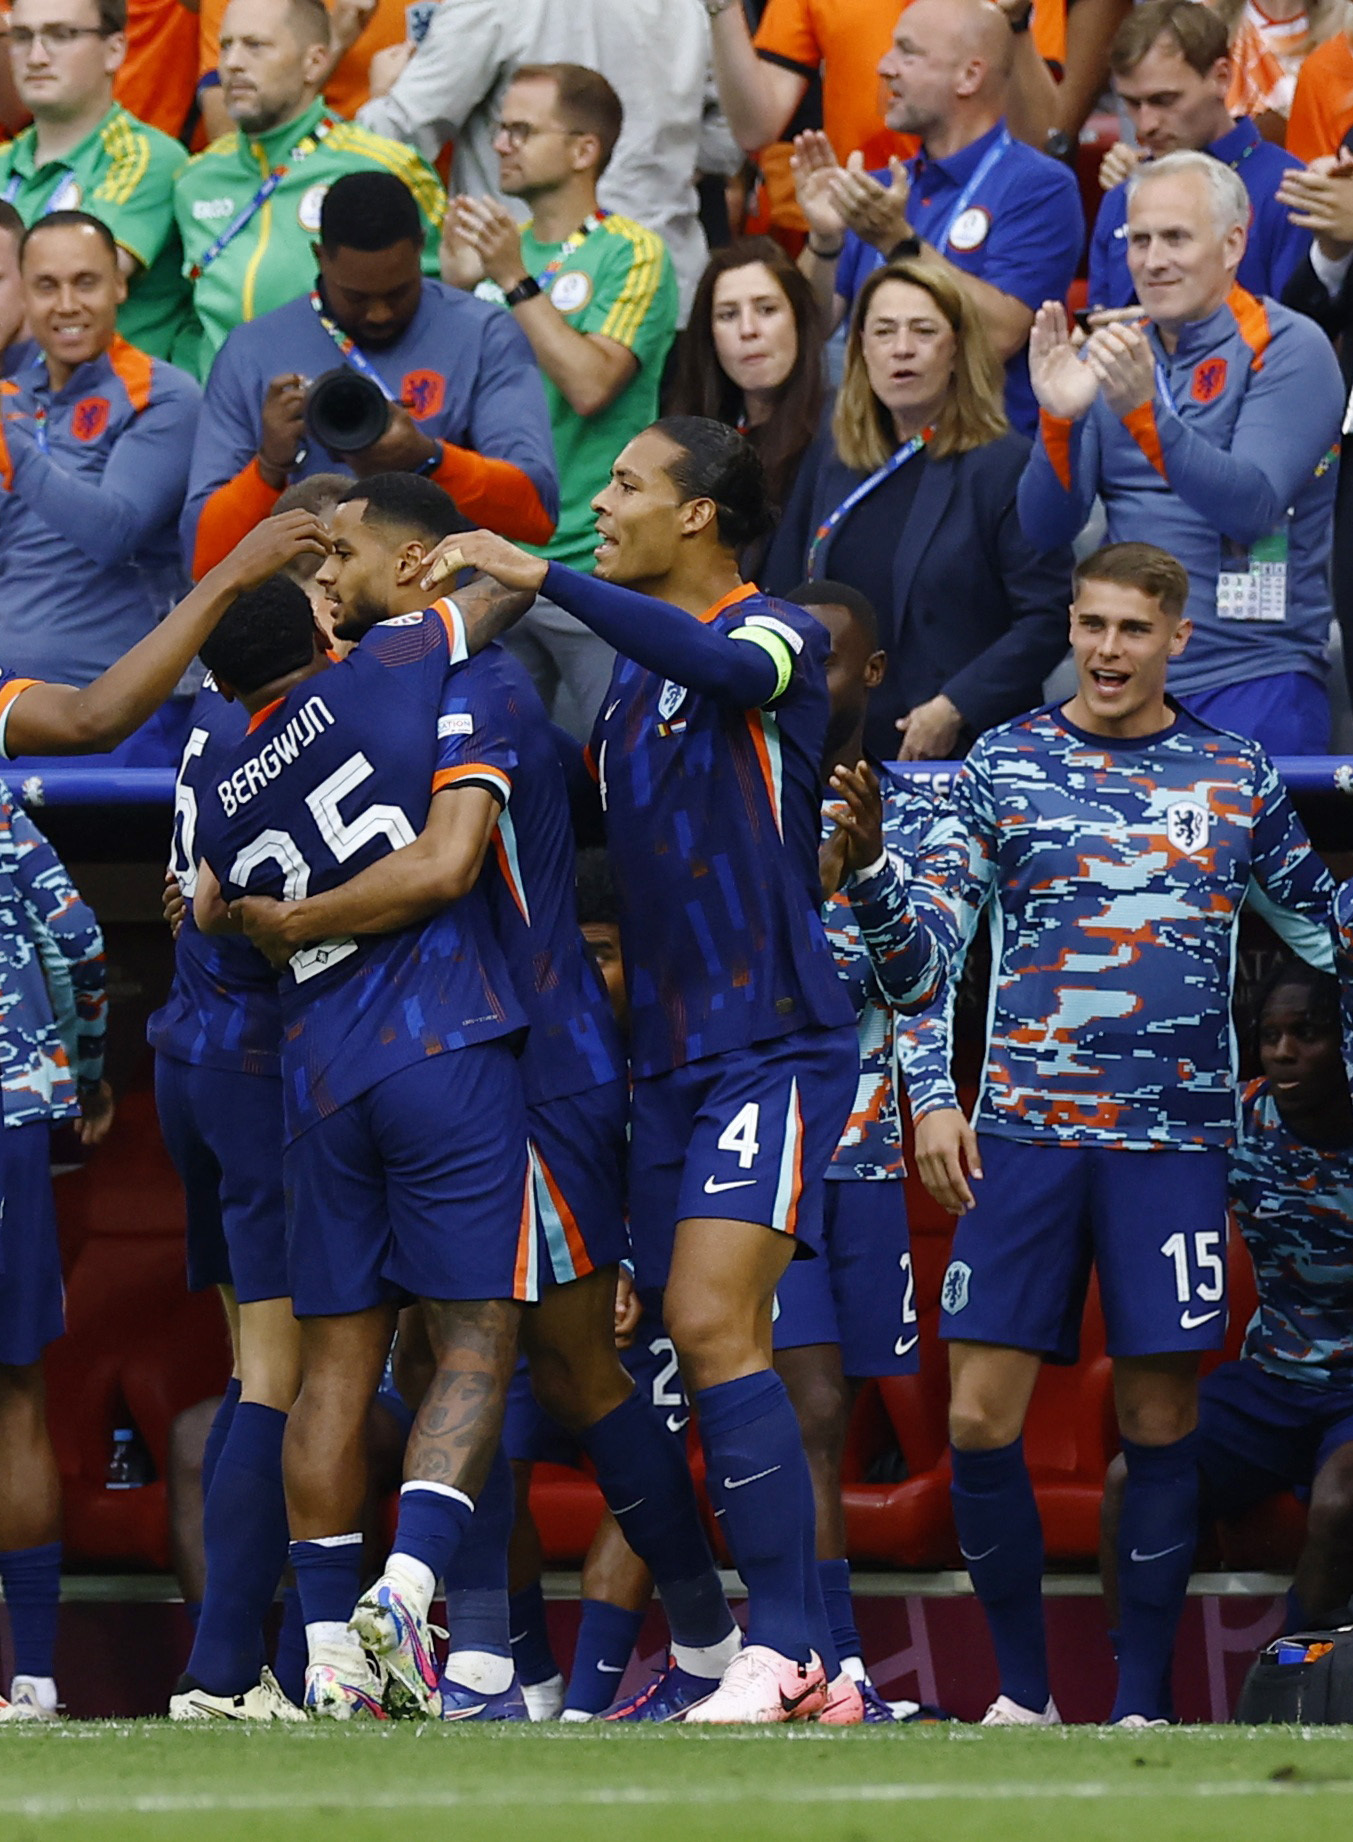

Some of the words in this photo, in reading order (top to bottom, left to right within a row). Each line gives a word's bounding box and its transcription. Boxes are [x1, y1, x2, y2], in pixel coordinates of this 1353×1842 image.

[216, 696, 336, 818] BERGWIJN
[717, 1102, 760, 1169] 4
[1160, 1231, 1225, 1303] 15
[648, 1337, 690, 1406] 2
